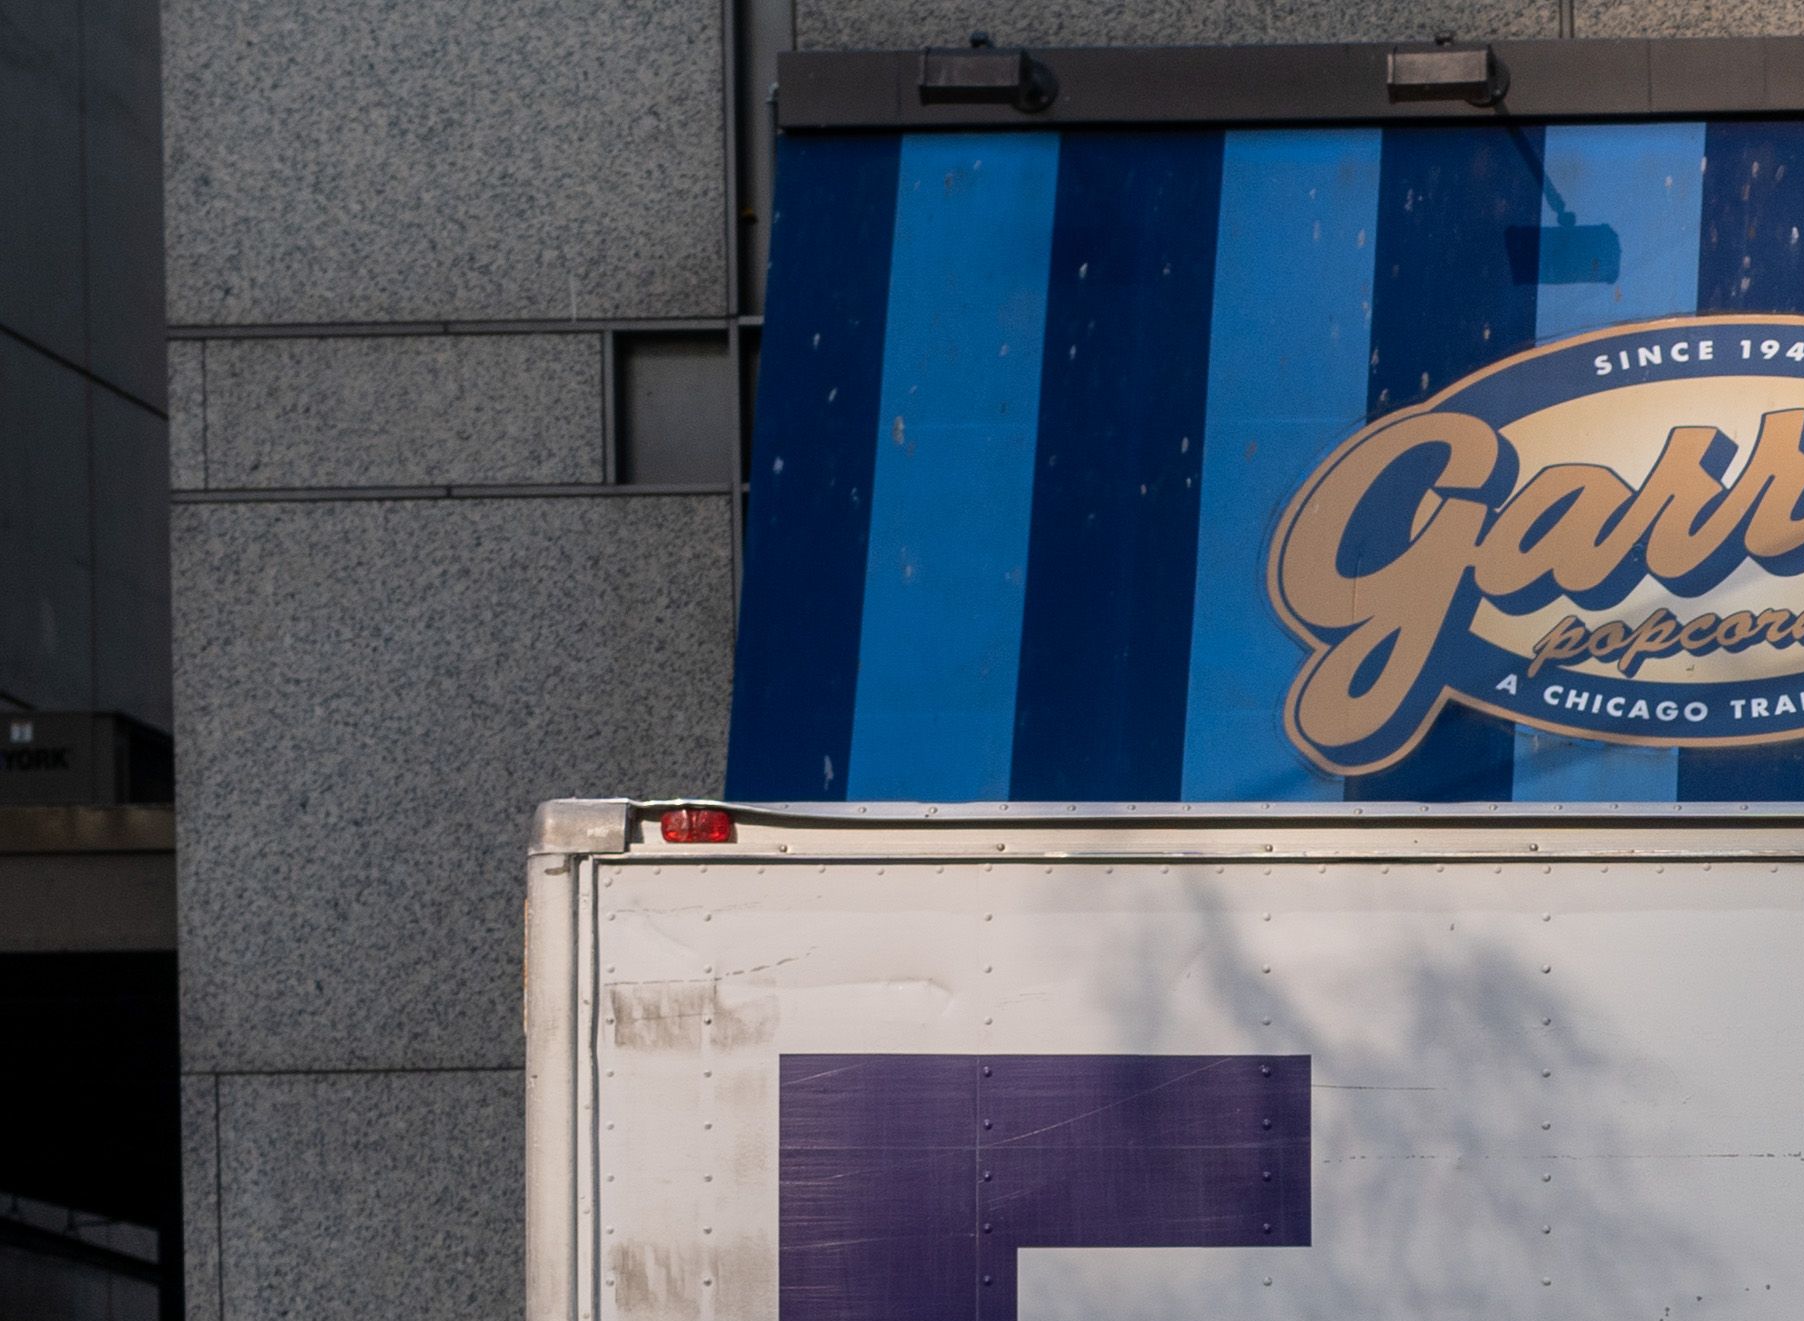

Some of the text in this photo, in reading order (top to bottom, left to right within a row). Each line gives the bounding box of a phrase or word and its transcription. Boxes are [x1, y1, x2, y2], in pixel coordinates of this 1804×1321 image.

[1592, 338, 1717, 376] SINCE
[1494, 668, 1519, 696] A
[1542, 683, 1709, 723] CHICAGO
